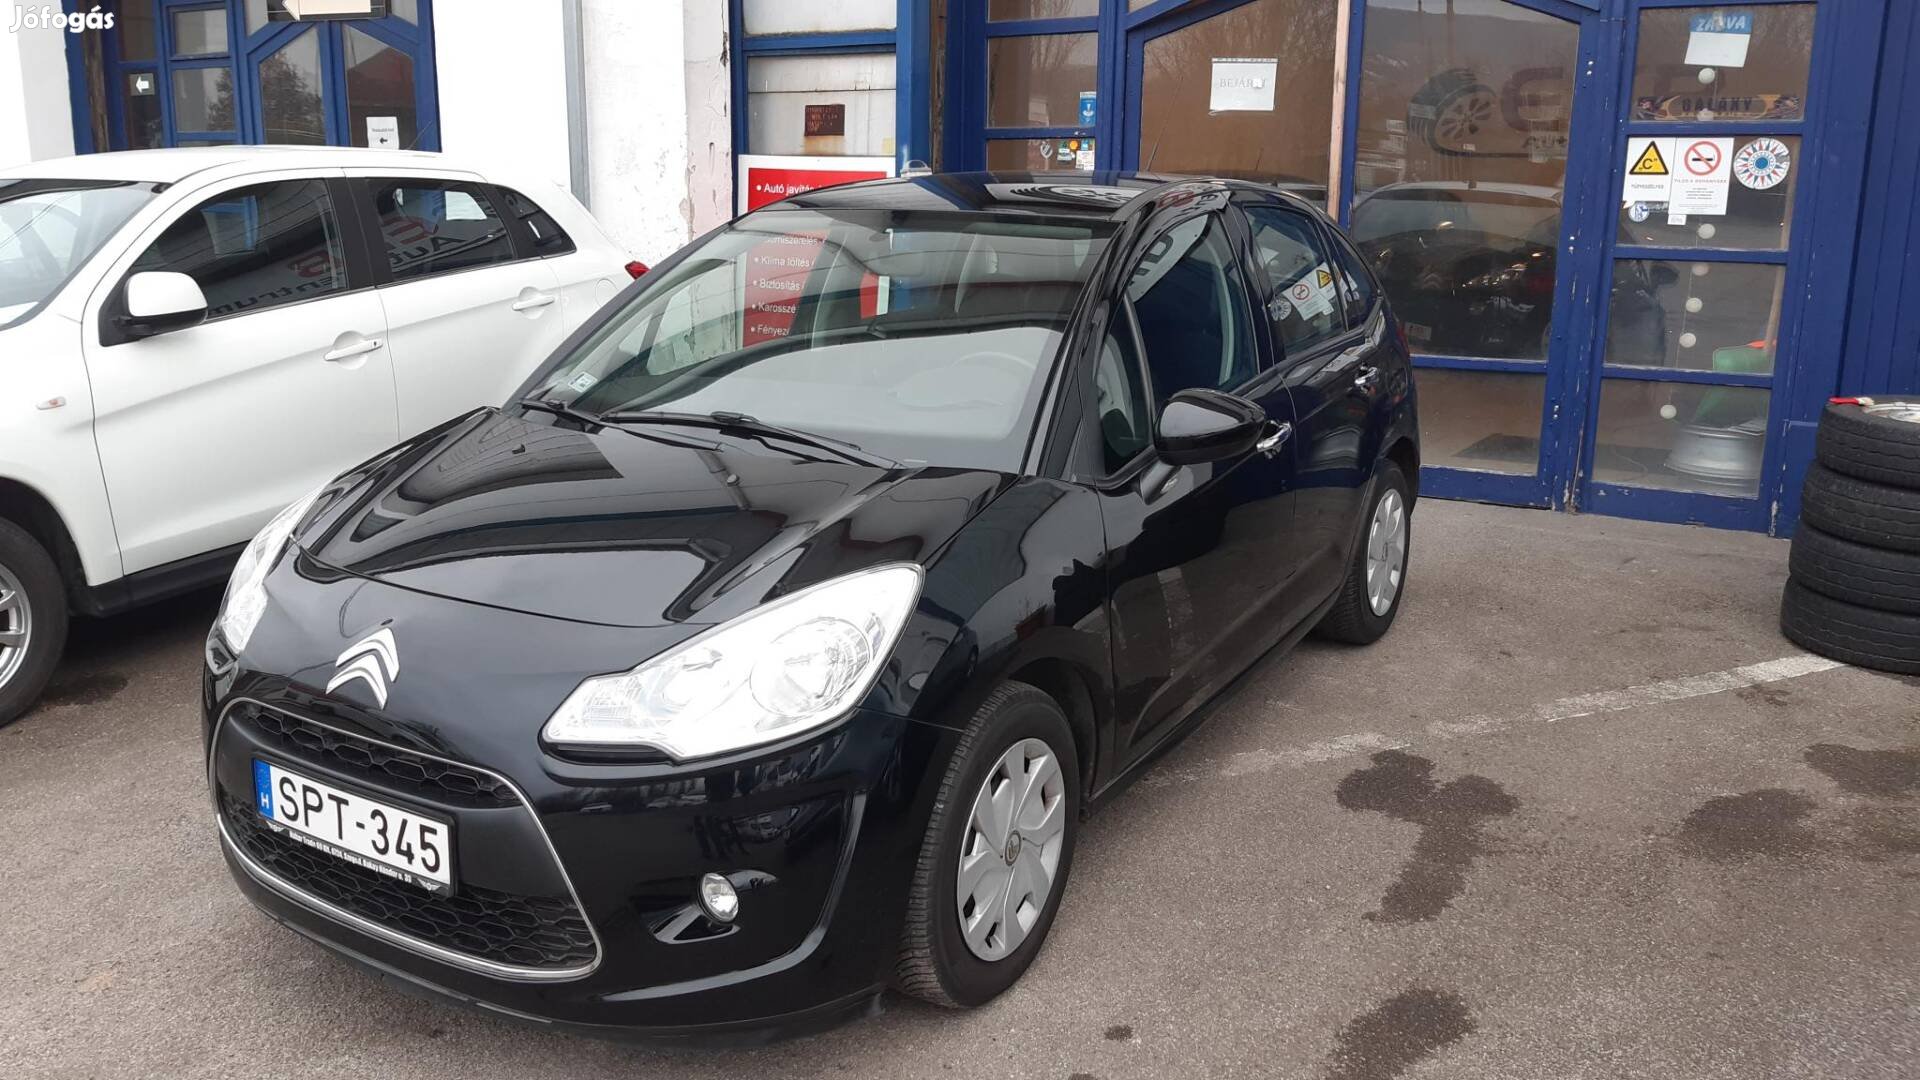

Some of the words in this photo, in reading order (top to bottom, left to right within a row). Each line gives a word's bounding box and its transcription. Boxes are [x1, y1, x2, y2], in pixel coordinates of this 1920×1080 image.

[1219, 76, 1267, 88] BEJÁRT
[763, 182, 785, 193] Autó
[757, 324, 790, 337] Fényez
[260, 792, 270, 809] H
[279, 776, 441, 873] SPT-345
